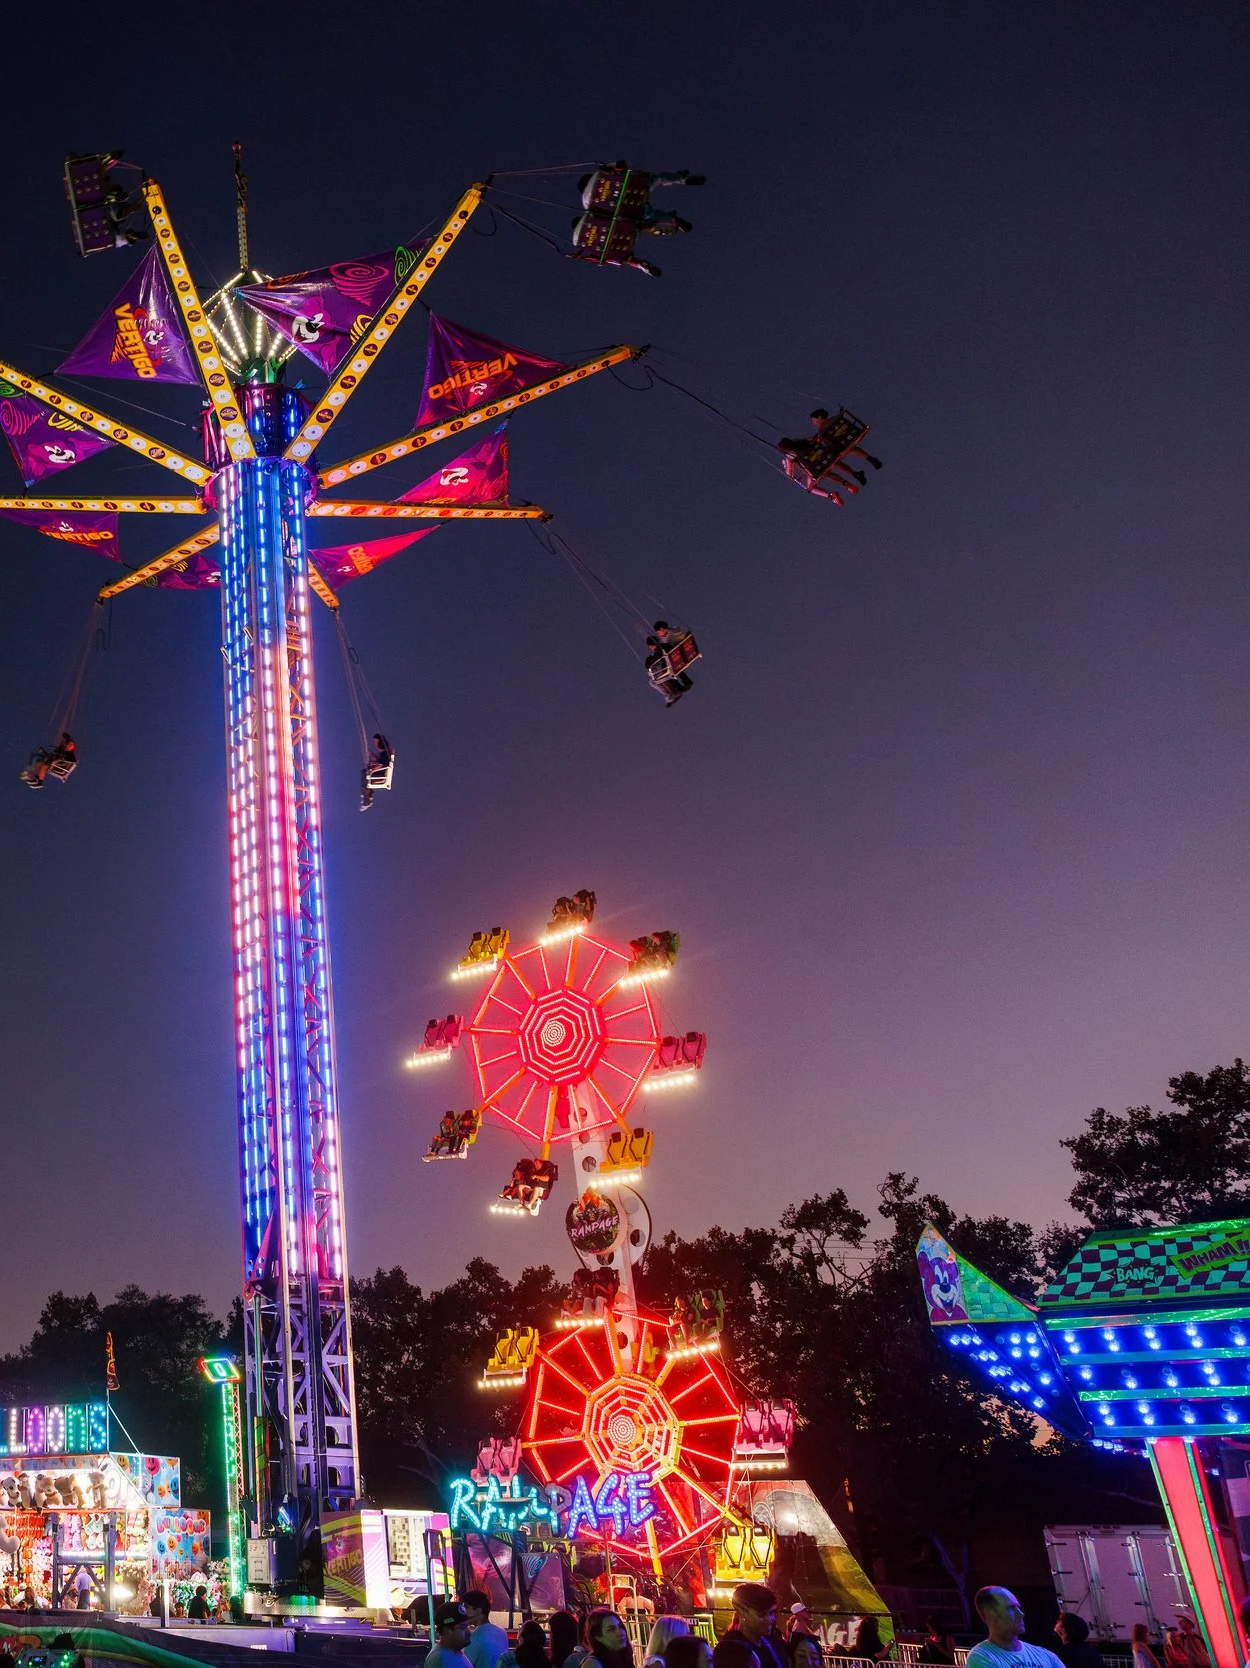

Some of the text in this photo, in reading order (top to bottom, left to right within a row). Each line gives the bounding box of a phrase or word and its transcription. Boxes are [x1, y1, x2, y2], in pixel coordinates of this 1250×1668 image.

[113, 302, 157, 378] VERTIGO
[428, 352, 518, 399] VERTIGO
[571, 1215, 619, 1238] RAMPAGE
[1116, 1266, 1155, 1283] BANG
[327, 1549, 362, 1577] VERTIGO
